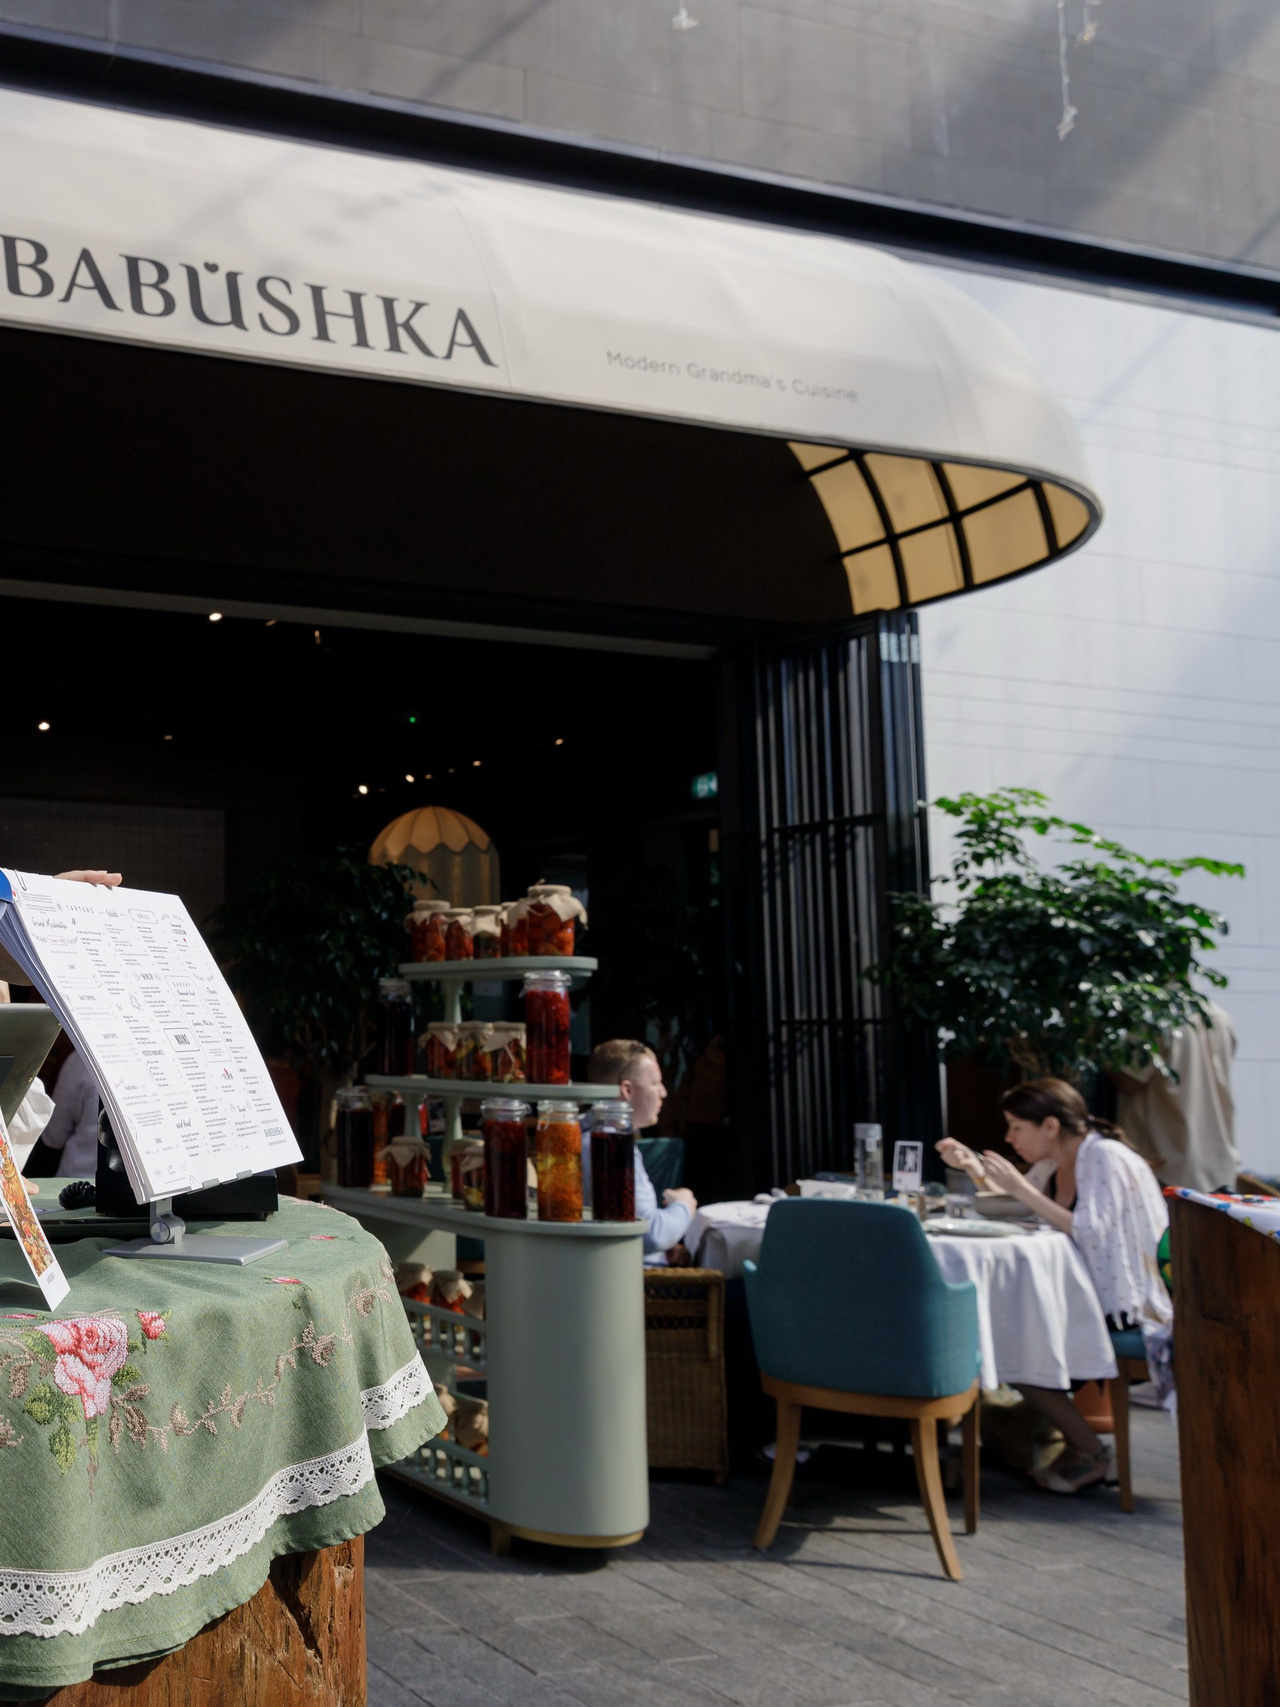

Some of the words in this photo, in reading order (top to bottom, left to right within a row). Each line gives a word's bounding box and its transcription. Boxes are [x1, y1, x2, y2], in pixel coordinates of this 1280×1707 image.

[605, 350, 681, 376] Modern
[686, 362, 787, 392] Grandma's
[792, 378, 859, 403] Cuisine
